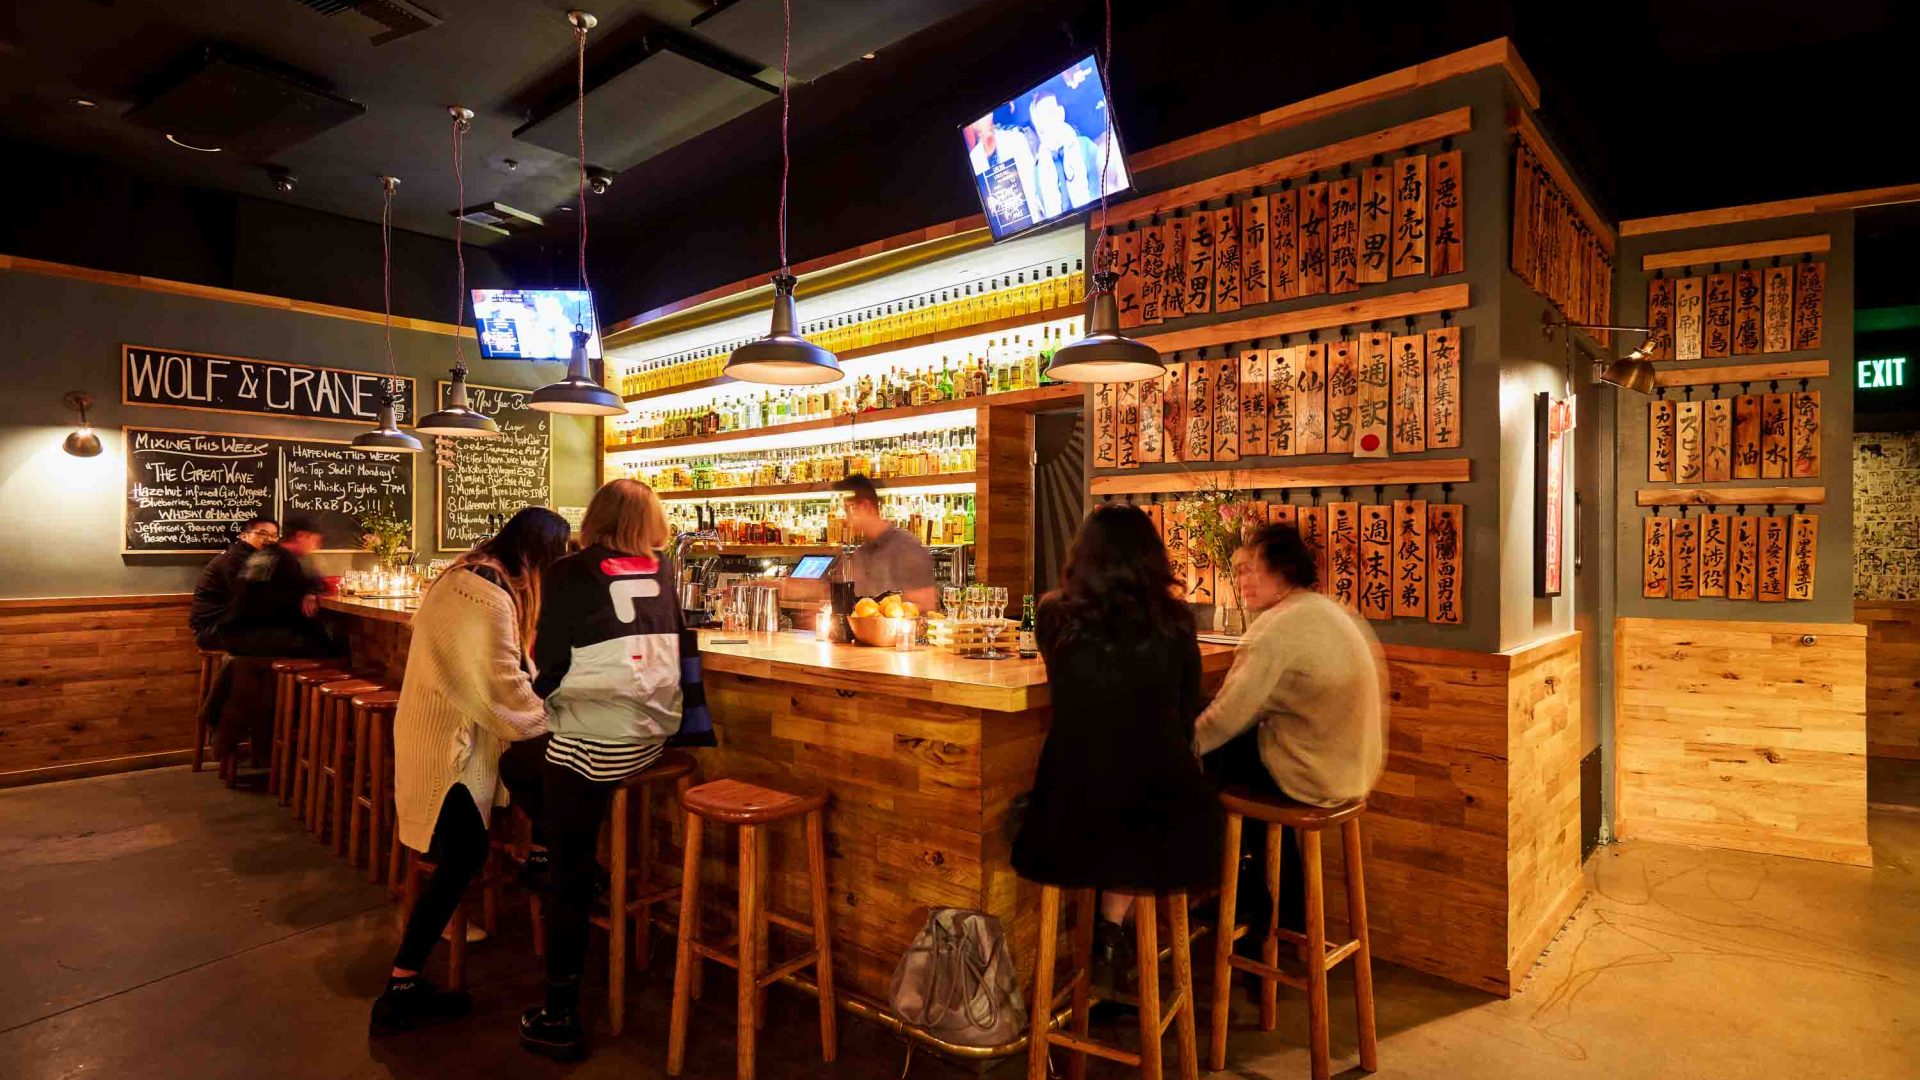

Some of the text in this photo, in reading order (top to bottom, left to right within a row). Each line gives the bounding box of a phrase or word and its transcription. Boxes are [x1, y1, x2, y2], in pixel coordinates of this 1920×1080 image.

[1299, 207, 1328, 278] 女将
[1330, 199, 1358, 288] 珈琲職人
[1361, 190, 1390, 270] 水男
[1394, 172, 1424, 267] 商売人
[1119, 252, 1140, 313] 大工
[1188, 228, 1214, 310] モテ男
[1218, 221, 1240, 305] 大爆笑
[1243, 219, 1267, 293] 市長
[130, 353, 378, 416] WOLF & CRANE
[1330, 363, 1358, 442] 飴男
[1358, 353, 1388, 430] 通訳
[1858, 357, 1906, 388] EXIT
[538, 420, 547, 431] 6
[540, 434, 549, 446] 7
[540, 447, 549, 460] 7
[1680, 415, 1701, 480] スピッツ
[313, 480, 346, 499] Whisky
[347, 482, 377, 498] Flights
[380, 483, 406, 495] 7PM
[516, 467, 536, 477] ESB
[538, 476, 546, 487] 7
[1331, 516, 1357, 605] 長髪男
[1361, 519, 1391, 611] 週末侍
[1398, 518, 1424, 608] 天使兄弟
[1703, 524, 1725, 589] 交渉役
[1760, 529, 1782, 595] 可愛い子達
[392, 982, 415, 991] FILA
